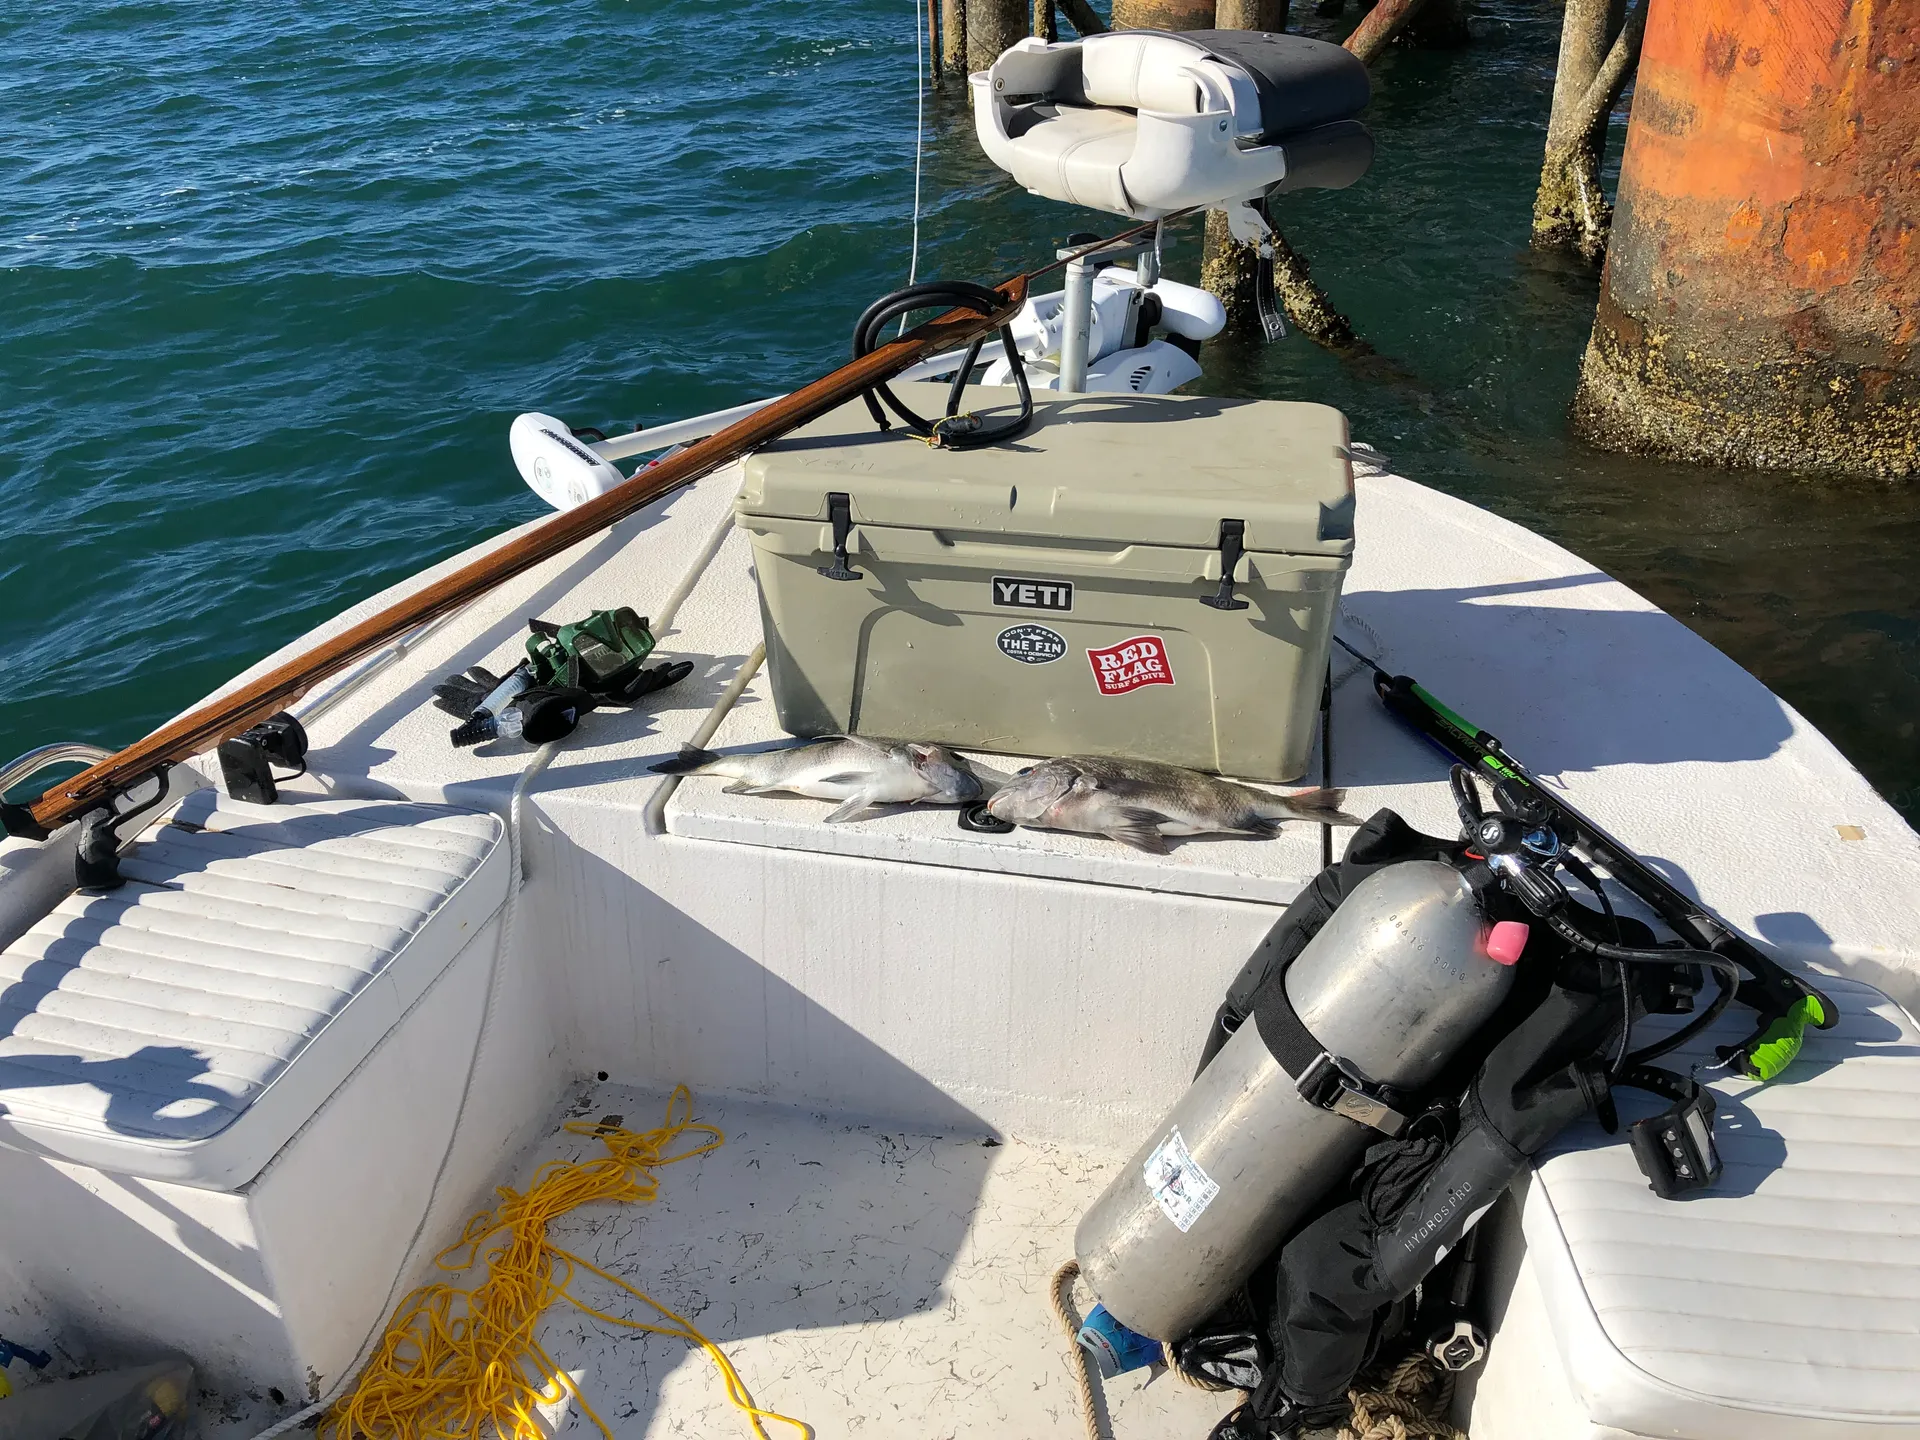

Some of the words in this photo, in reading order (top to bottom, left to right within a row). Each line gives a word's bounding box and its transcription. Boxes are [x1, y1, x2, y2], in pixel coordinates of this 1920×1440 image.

[996, 582, 1066, 607] YETI
[1001, 638, 1030, 651] THE
[1035, 641, 1062, 654] FIN
[1004, 627, 1033, 638] DON'T
[1035, 628, 1060, 643] FEAR
[1095, 642, 1159, 670] RED
[1100, 658, 1163, 684] FLAG
[1105, 679, 1131, 690] SURF
[1132, 676, 1140, 684] &
[1141, 672, 1166, 681] DIVE
[1404, 1205, 1450, 1252] HYDROS
[1448, 1181, 1473, 1207] PRO
